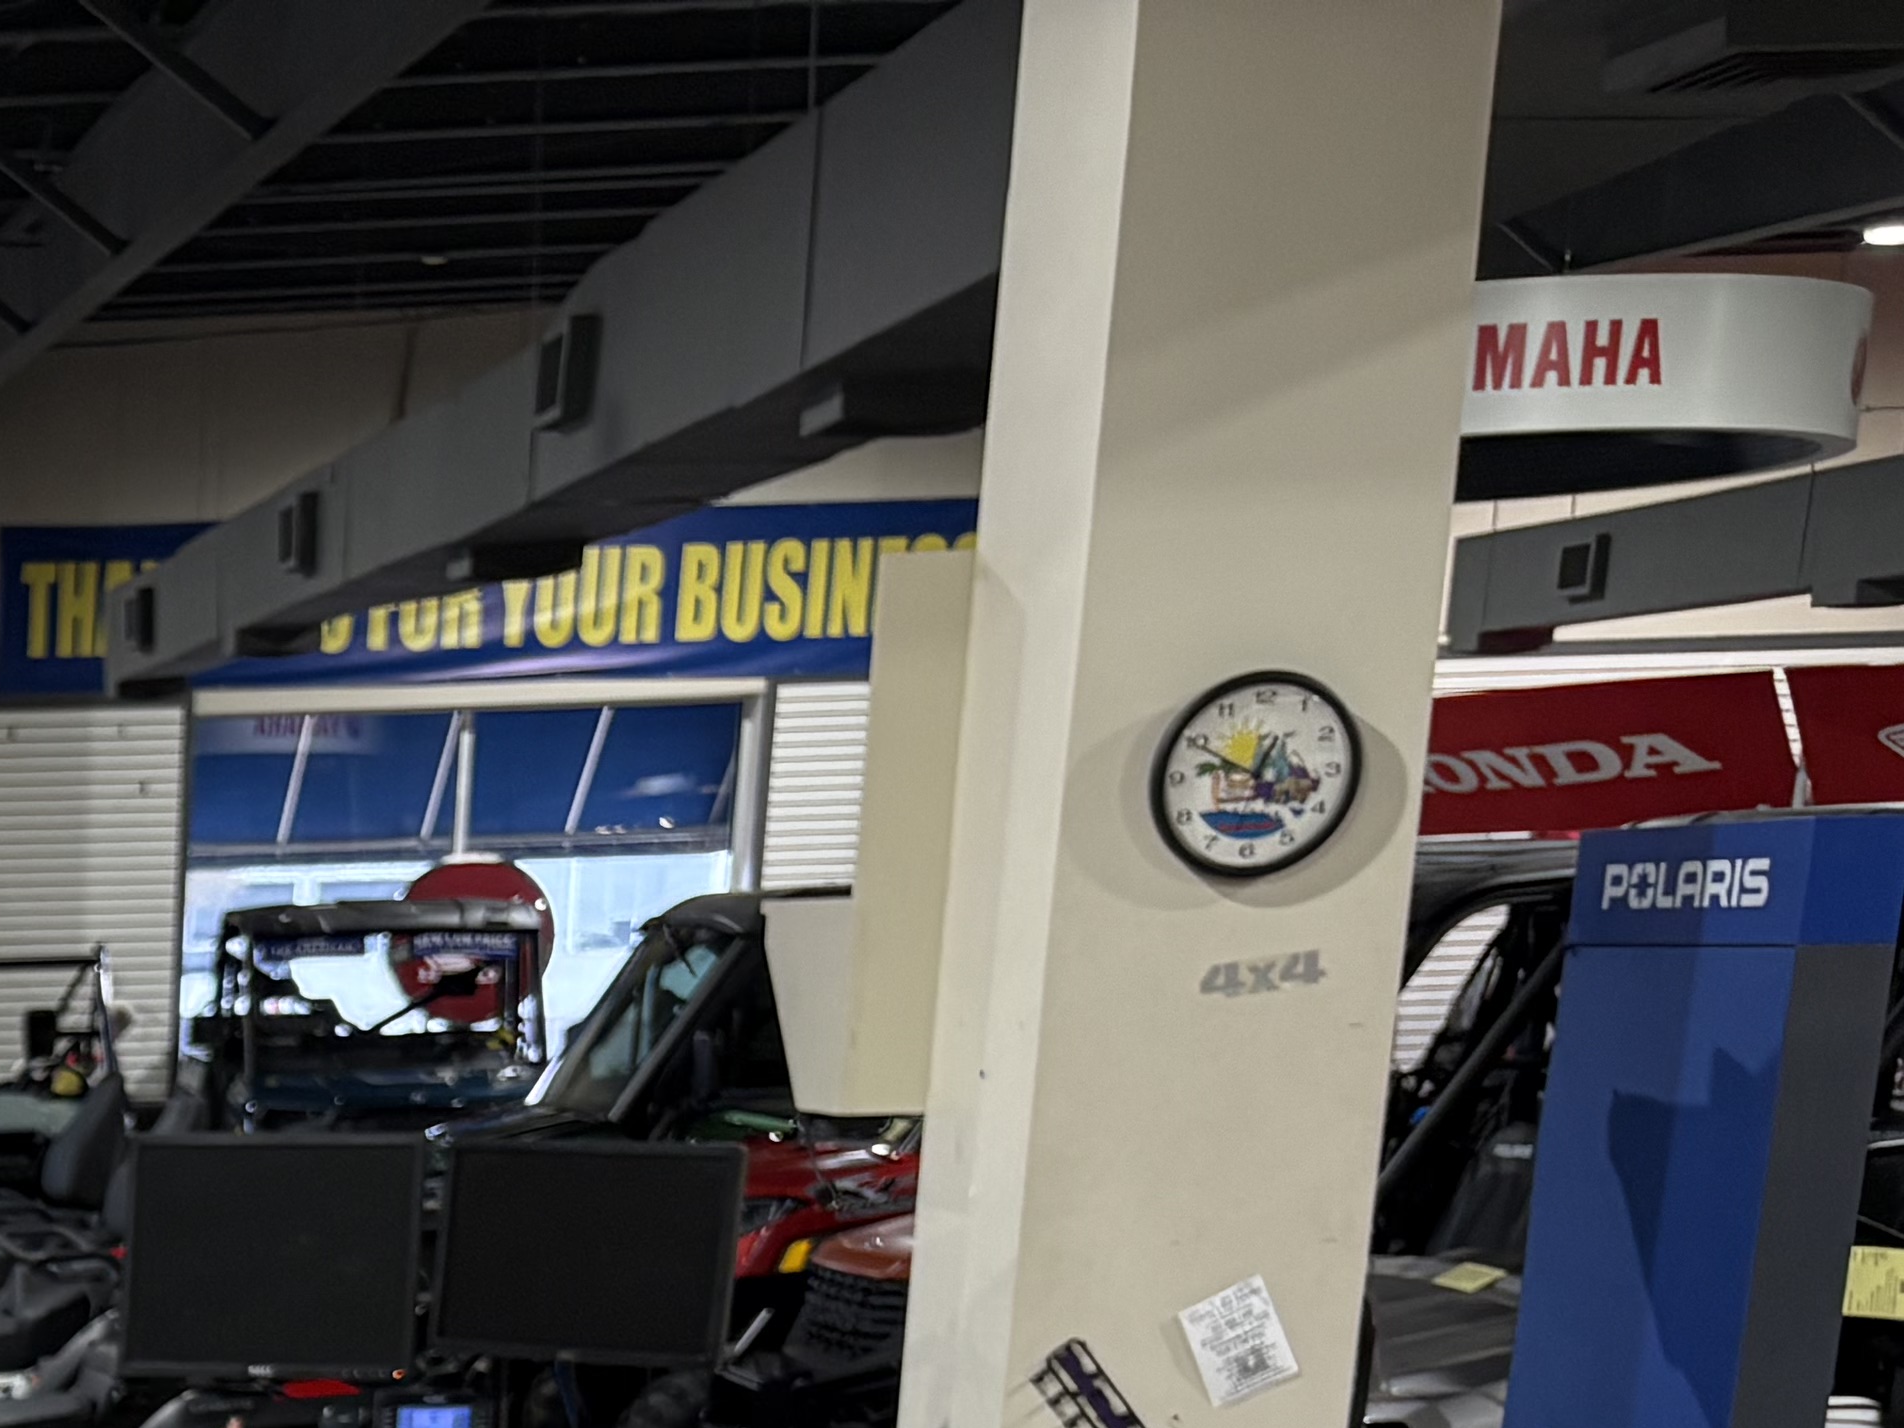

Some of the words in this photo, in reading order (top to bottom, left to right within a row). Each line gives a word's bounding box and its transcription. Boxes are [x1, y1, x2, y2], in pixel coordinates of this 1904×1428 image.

[1472, 317, 1662, 391] MAHA
[501, 543, 666, 649] YOUR
[1423, 733, 1723, 794] ONDA
[1602, 857, 1771, 910] POLARIS
[1199, 949, 1326, 997] 4x4
